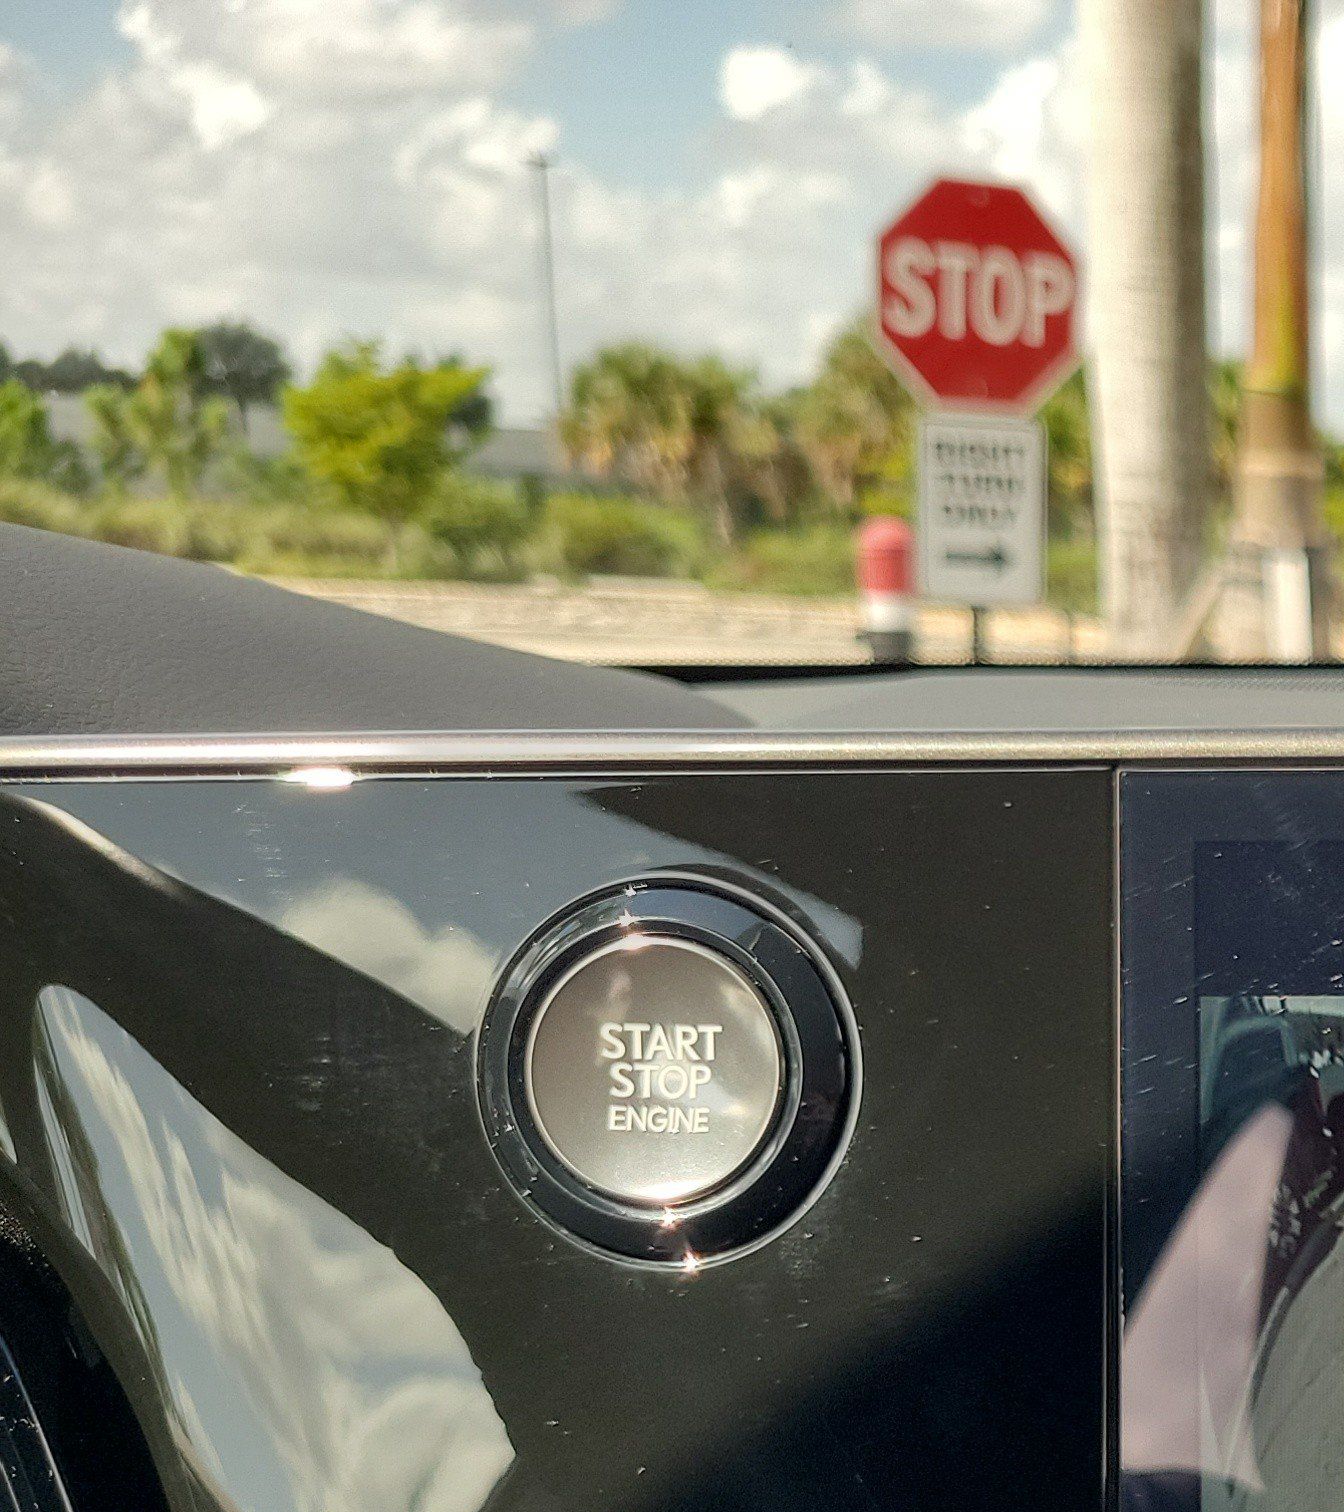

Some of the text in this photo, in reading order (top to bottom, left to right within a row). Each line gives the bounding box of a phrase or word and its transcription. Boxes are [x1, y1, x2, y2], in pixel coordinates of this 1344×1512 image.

[882, 237, 1072, 348] STOP
[601, 1023, 722, 1061] START
[609, 1063, 711, 1100] STOP
[608, 1105, 709, 1133] ENGINE
